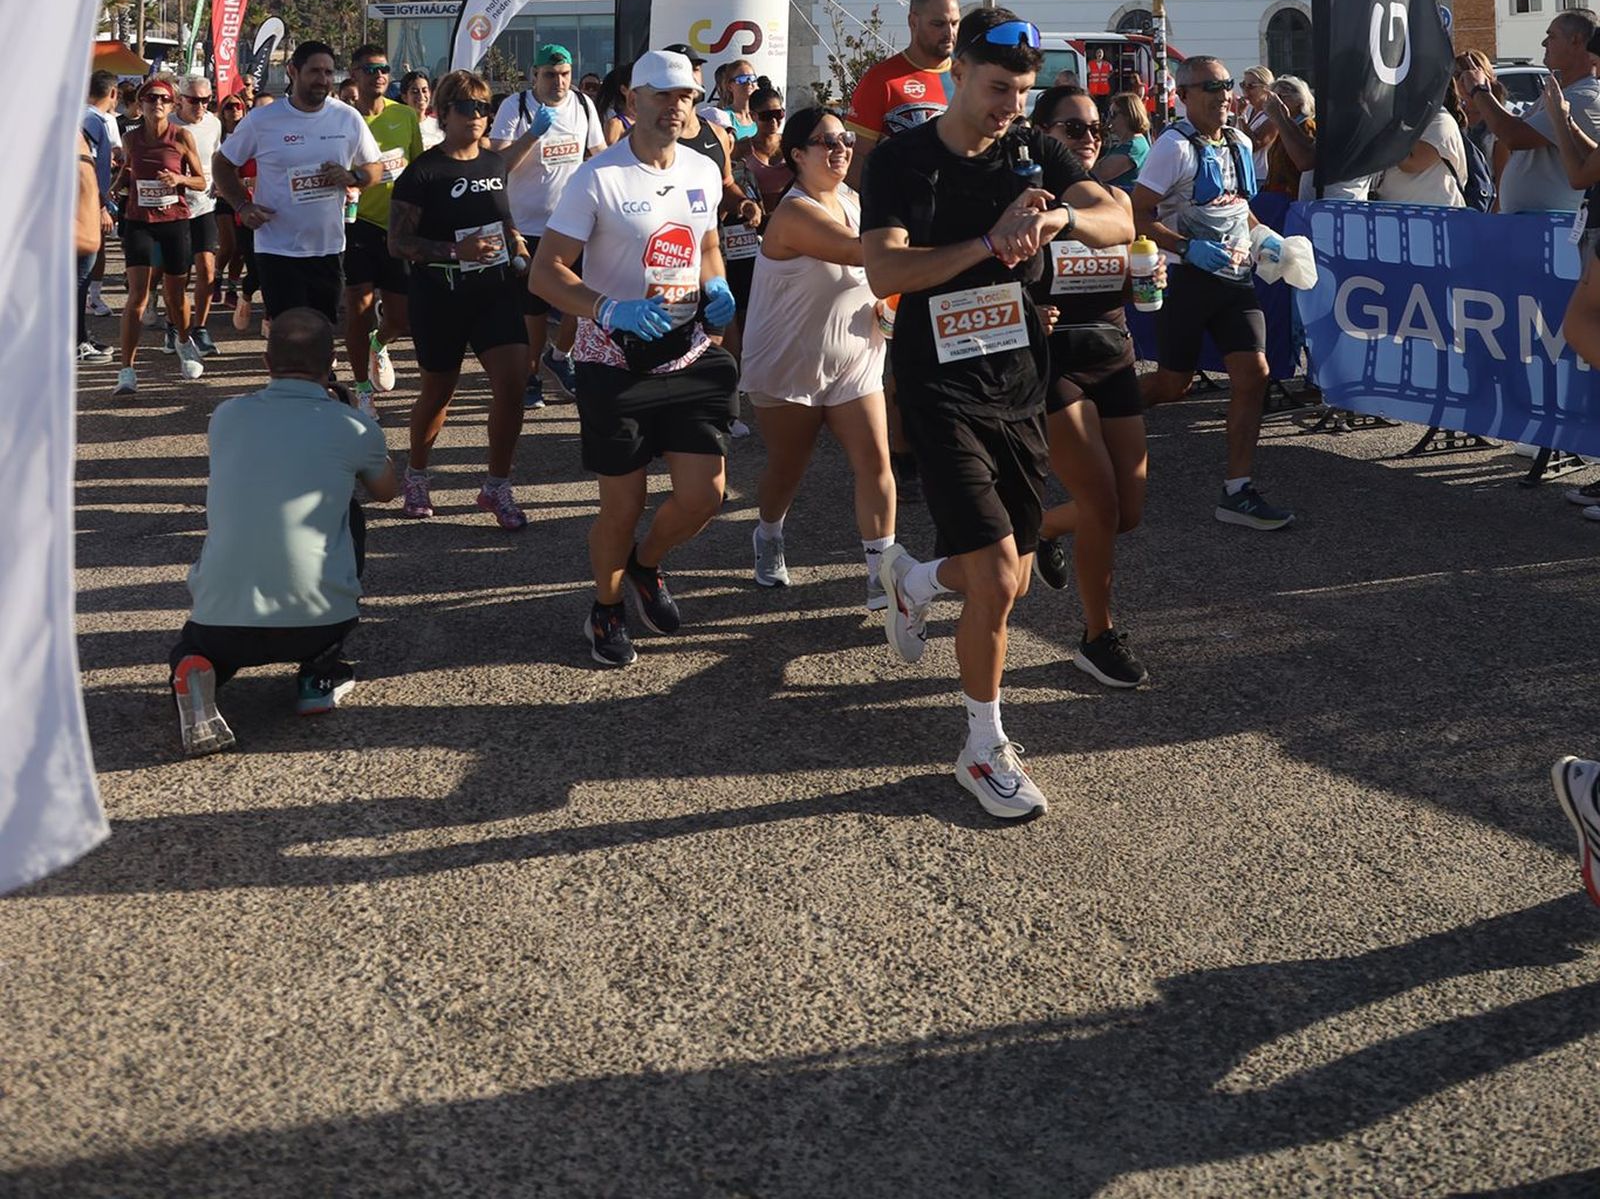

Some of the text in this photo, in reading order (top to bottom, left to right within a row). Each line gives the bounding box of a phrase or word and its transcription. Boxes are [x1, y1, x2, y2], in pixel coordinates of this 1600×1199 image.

[545, 144, 578, 157] 24372
[384, 159, 402, 170] 397
[295, 176, 332, 189] 2437
[654, 240, 693, 258] PONLE
[1062, 258, 1121, 275] 24938
[943, 304, 1014, 335] 24937
